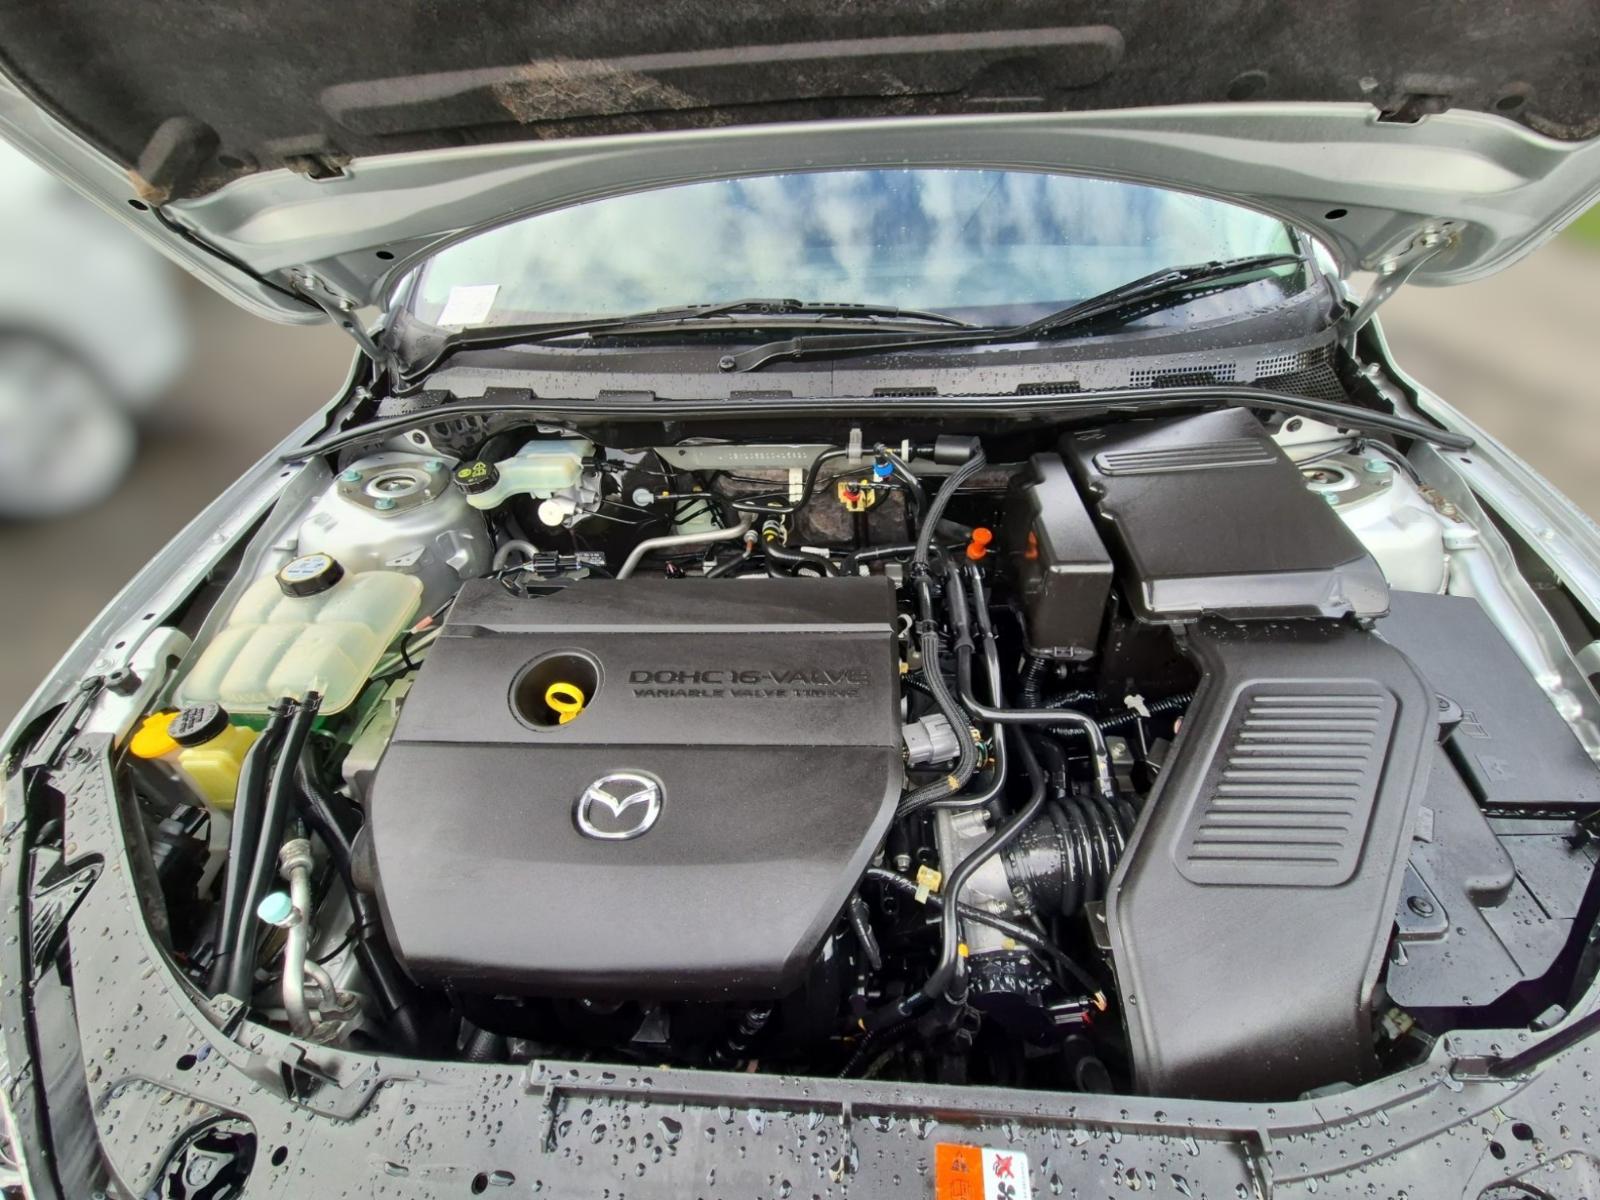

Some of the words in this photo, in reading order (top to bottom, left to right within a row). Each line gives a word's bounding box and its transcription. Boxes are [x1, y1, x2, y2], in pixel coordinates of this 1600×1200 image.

[628, 670, 724, 685] DOHC
[731, 670, 870, 686] 16-VALVE
[632, 688, 724, 699] VARIABLE
[729, 688, 787, 699] VALVE
